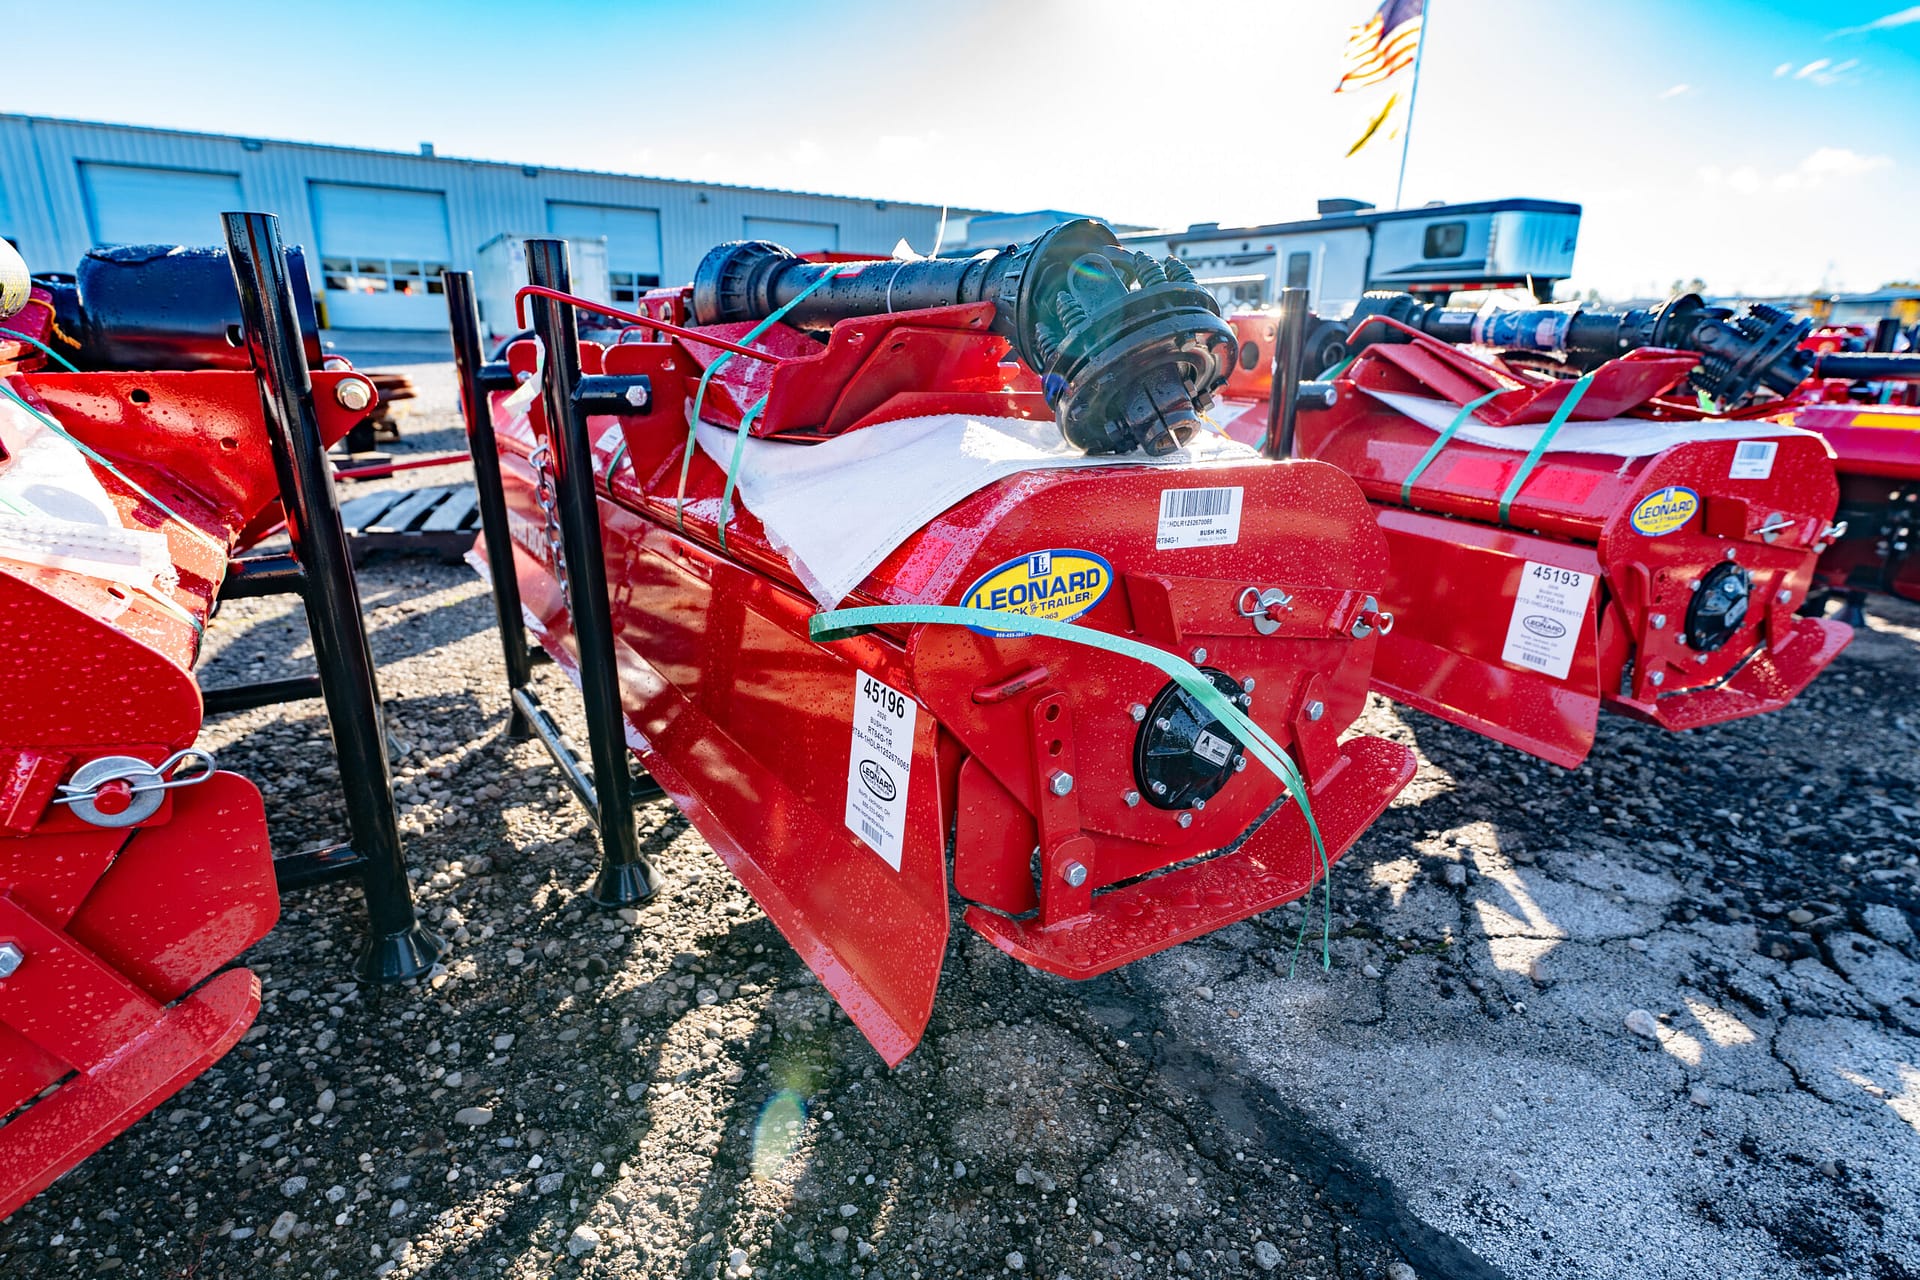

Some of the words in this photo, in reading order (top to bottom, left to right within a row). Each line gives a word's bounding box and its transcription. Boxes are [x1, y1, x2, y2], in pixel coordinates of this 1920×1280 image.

[1638, 500, 1694, 520] LEONARD
[1532, 565, 1581, 588] 45193
[975, 567, 1101, 612] LEONARD
[1040, 592, 1090, 611] TRAILER
[1526, 618, 1563, 634] LEONARD
[863, 677, 906, 719] 45196
[862, 764, 894, 794] LEONARD
